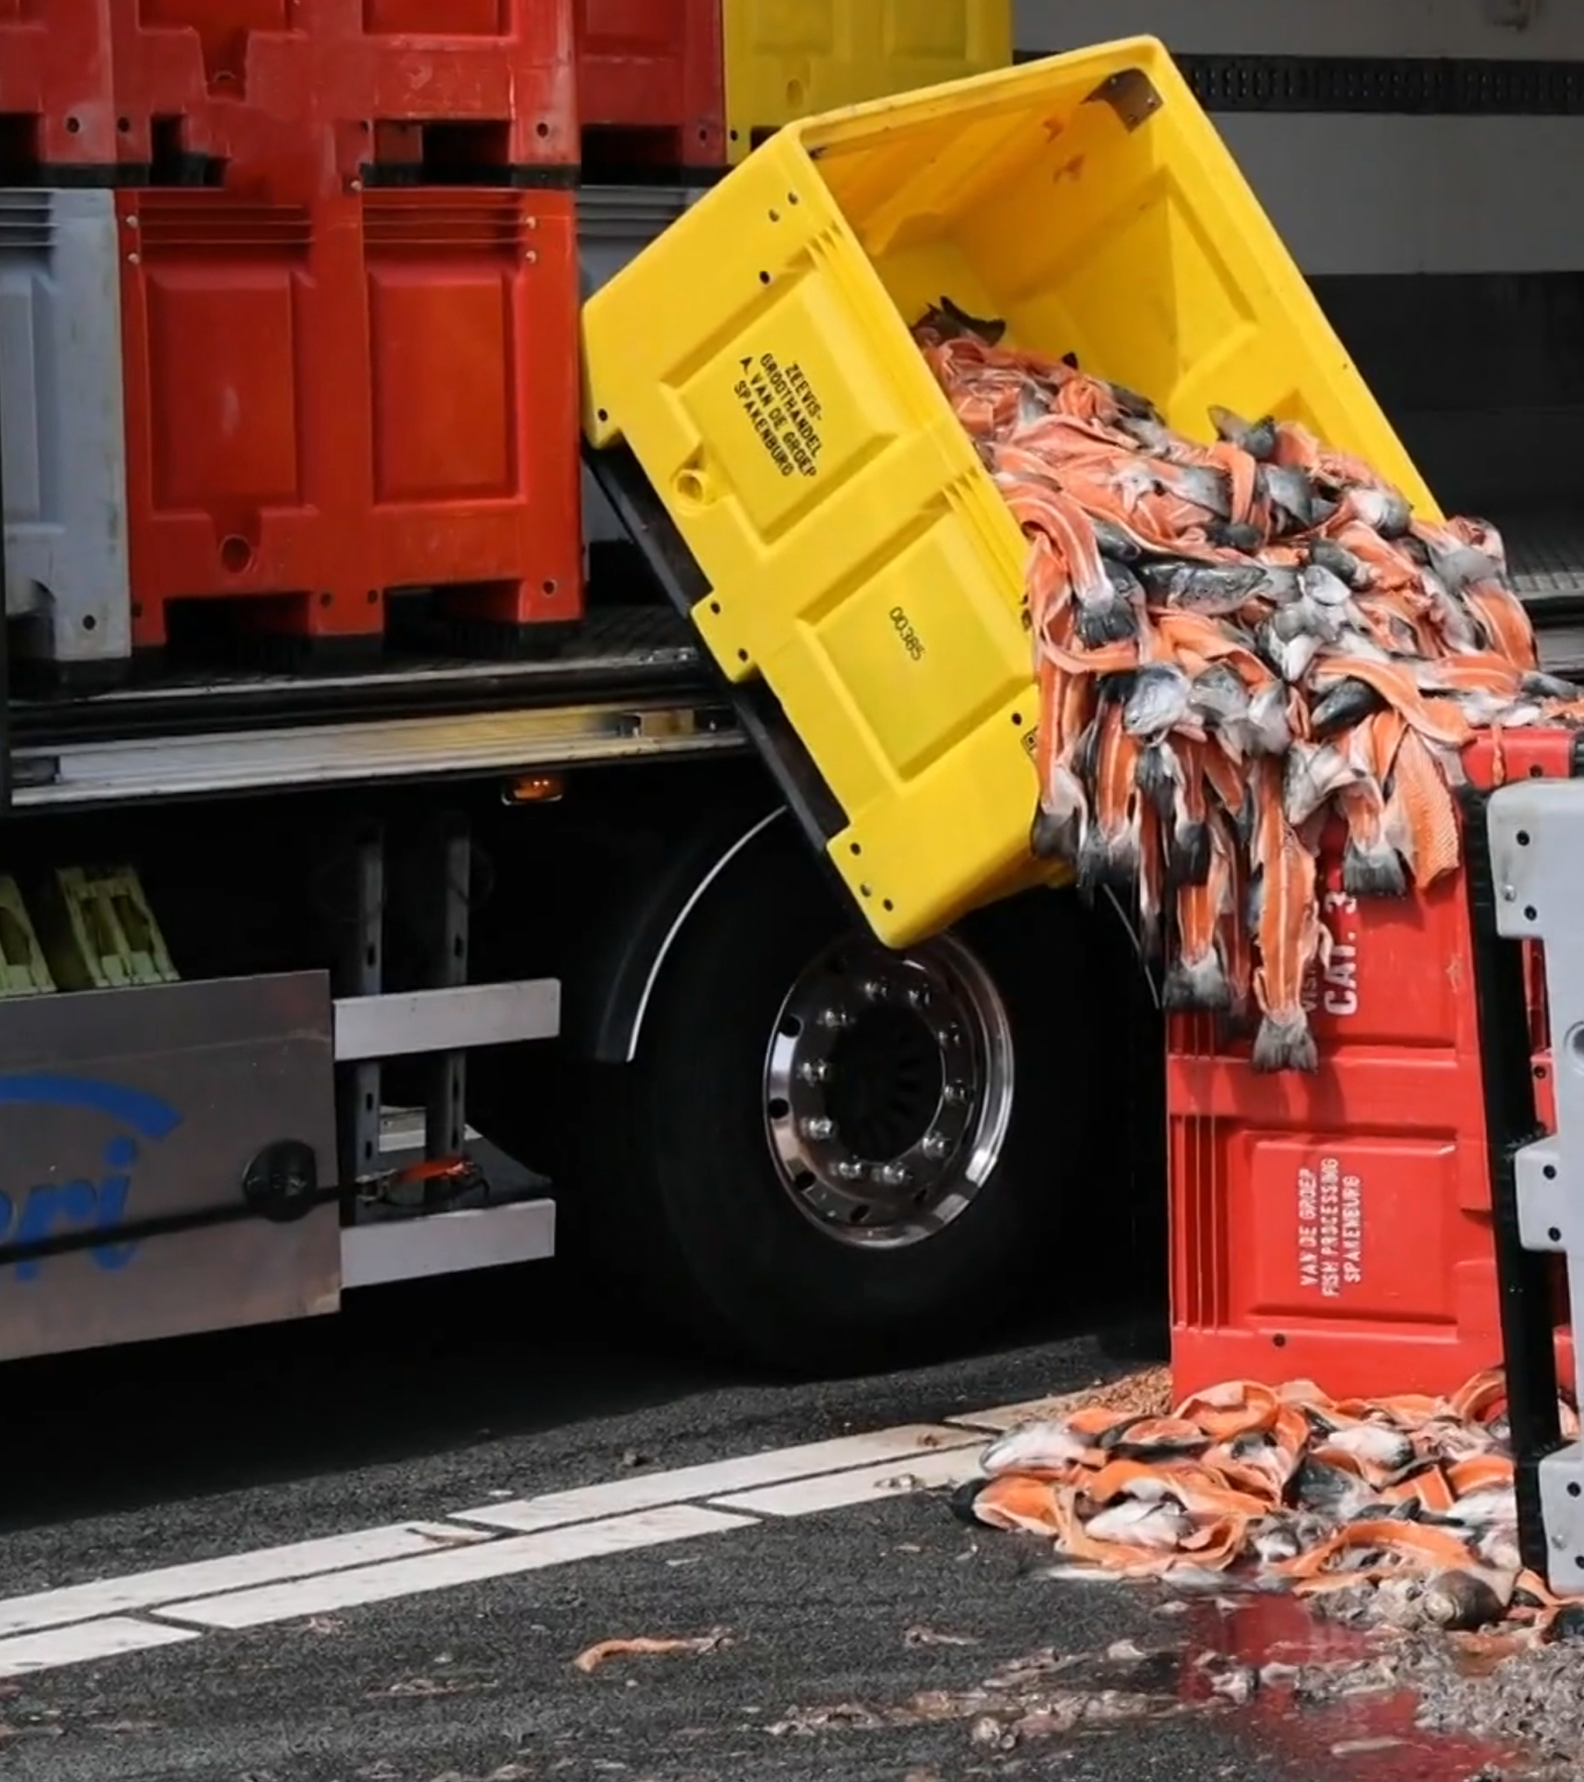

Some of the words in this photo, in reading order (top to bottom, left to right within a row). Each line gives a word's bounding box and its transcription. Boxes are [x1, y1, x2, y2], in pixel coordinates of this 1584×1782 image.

[760, 352, 824, 459] GROOTHANDEL
[784, 362, 822, 421] ZEEVIS-
[733, 379, 795, 476] SPAKENBURG
[750, 373, 775, 407] VAN
[767, 407, 788, 431] DE
[782, 431, 817, 476] GROEP
[1324, 890, 1358, 914] 3
[1298, 1168, 1318, 1220] GROEP
[1320, 1157, 1339, 1256] PROCESSING
[1298, 1226, 1318, 1248] DE
[1342, 1175, 1361, 1283] SPAKENBURG
[1299, 1252, 1319, 1287] VAN
[1320, 1261, 1340, 1297] FISH
